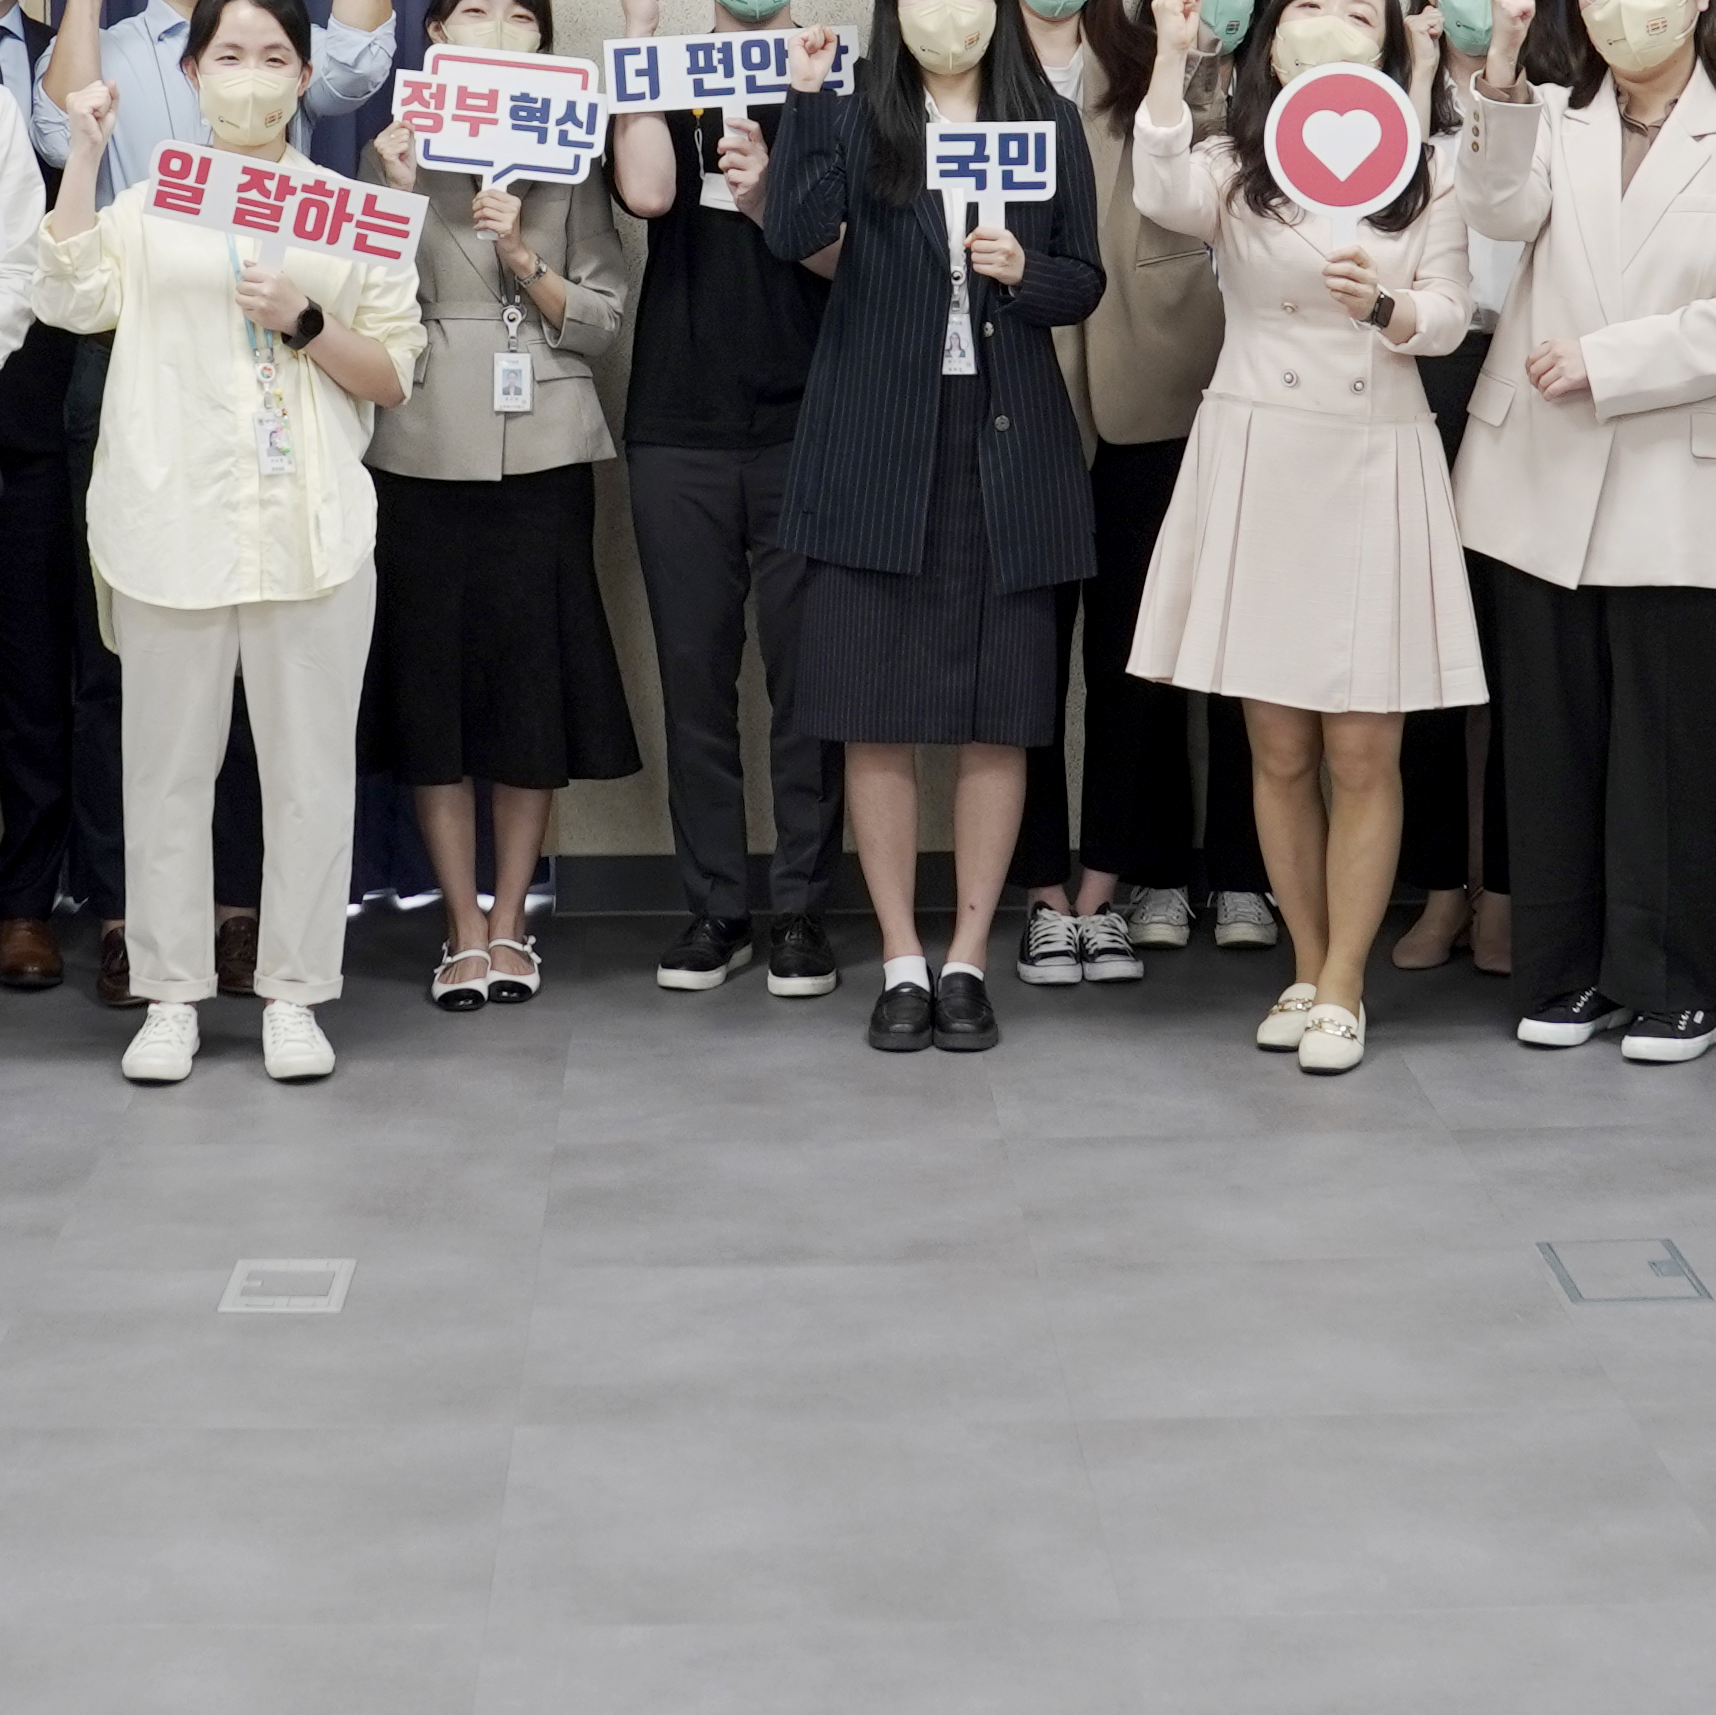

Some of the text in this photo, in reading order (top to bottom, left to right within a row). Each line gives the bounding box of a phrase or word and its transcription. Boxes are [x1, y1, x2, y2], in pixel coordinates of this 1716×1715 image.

[613, 45, 660, 102] 더
[937, 131, 1047, 191] 국민
[152, 148, 411, 260] 일 잘하는
